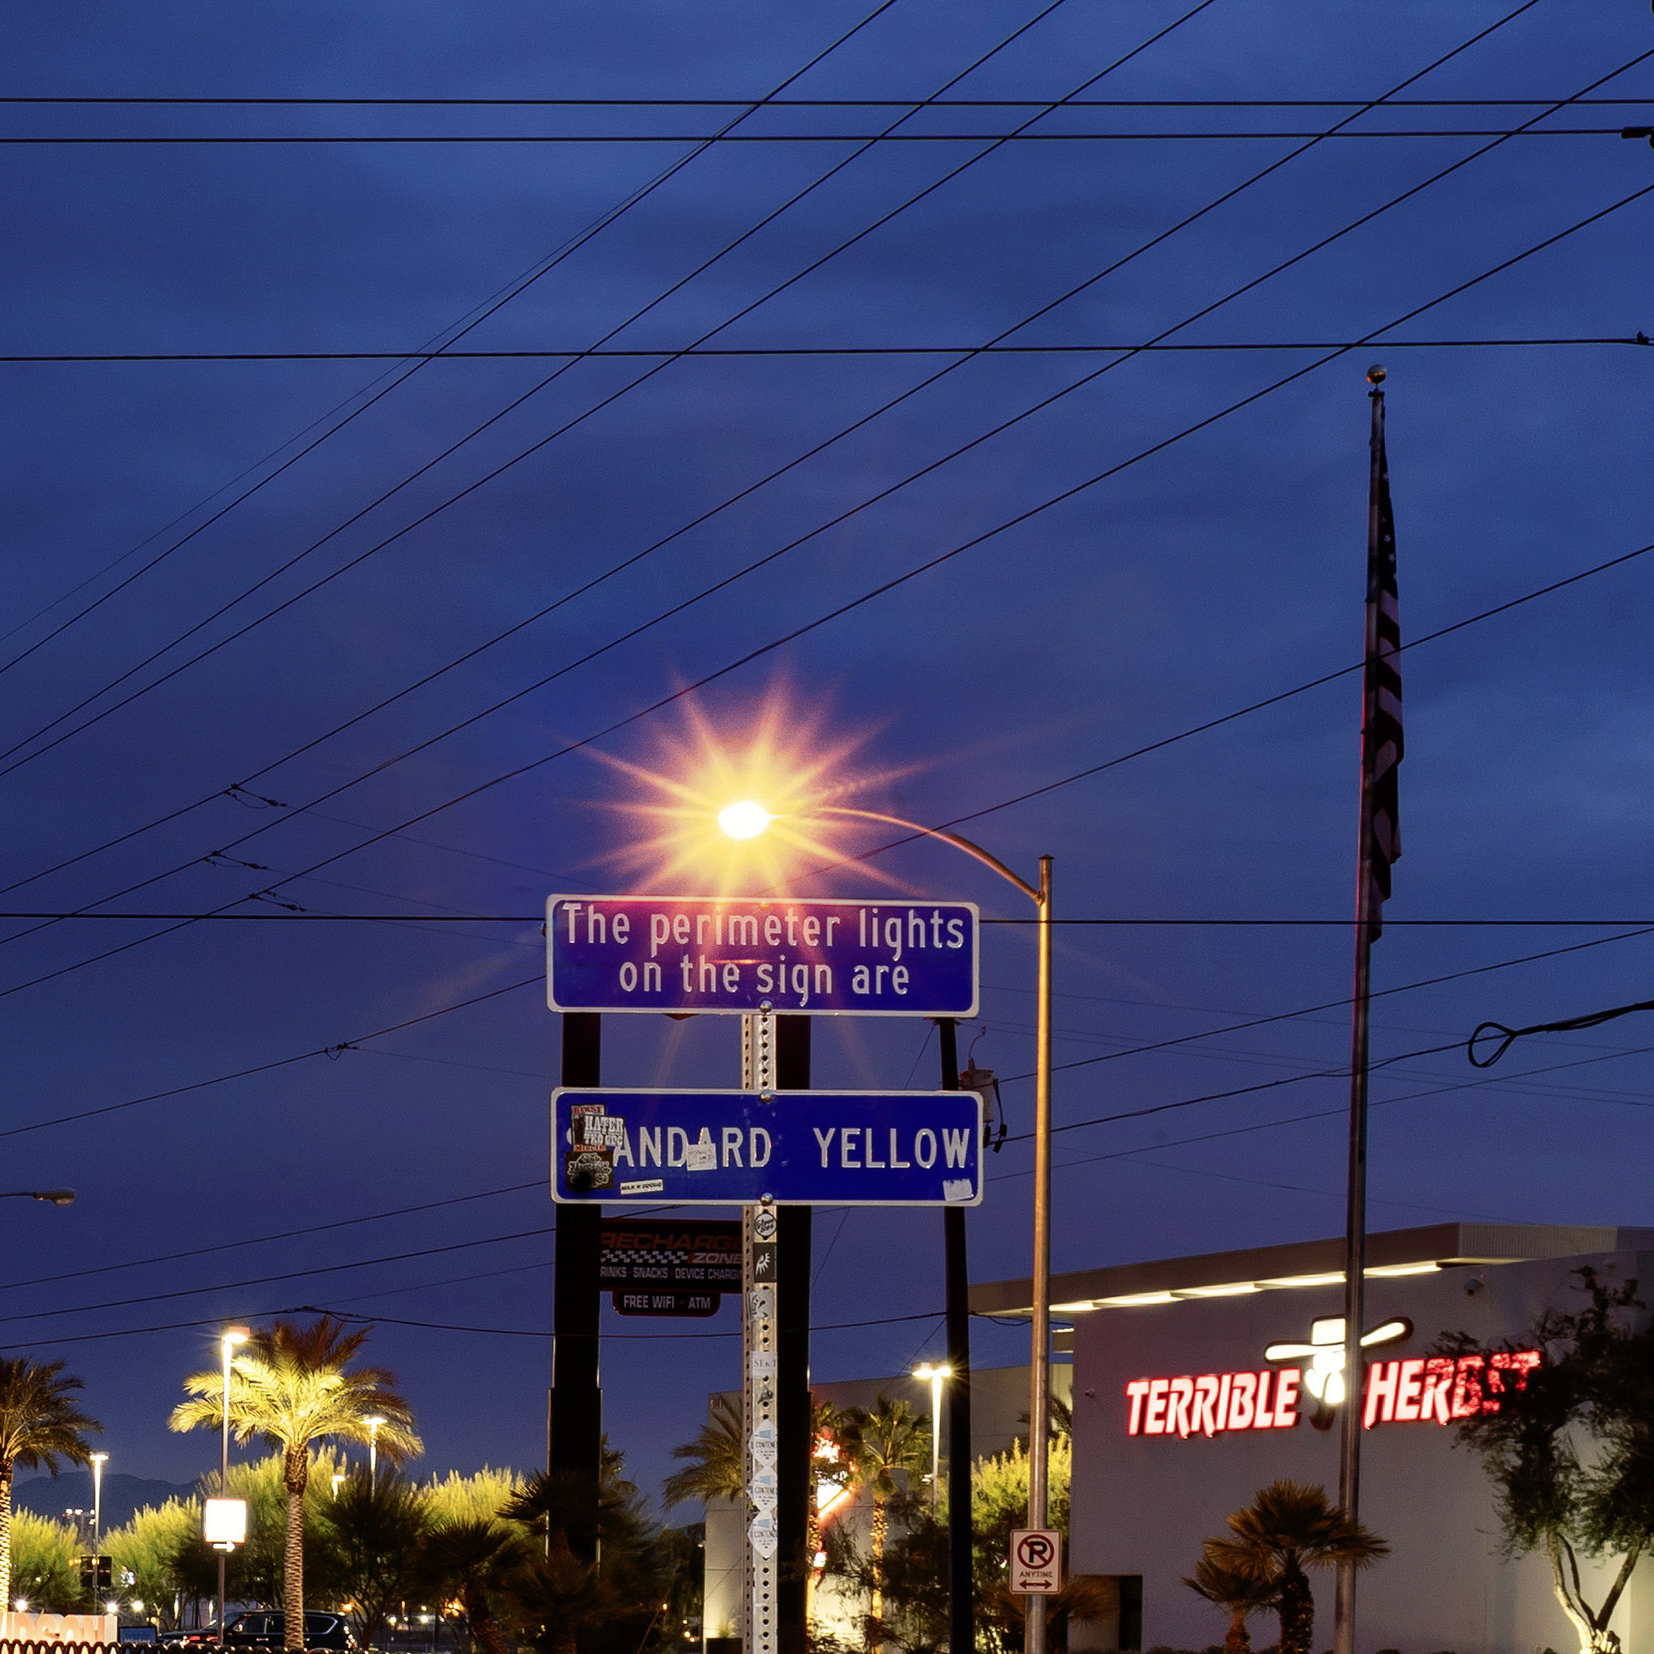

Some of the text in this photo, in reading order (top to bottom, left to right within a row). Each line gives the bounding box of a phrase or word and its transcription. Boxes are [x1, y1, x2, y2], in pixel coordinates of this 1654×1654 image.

[563, 902, 965, 962] The perimeter lights
[619, 954, 910, 1007] on the sign are
[566, 1126, 971, 1170] ANDRD YELLOW
[600, 1266, 627, 1278] RINKS
[633, 1266, 669, 1279] SNACKS
[675, 1268, 705, 1280] DEVICE
[623, 1294, 711, 1310] FREE WIFI ATM
[1126, 1368, 1301, 1440] TERRIBLE
[1019, 1570, 1054, 1578] ANYTIME
